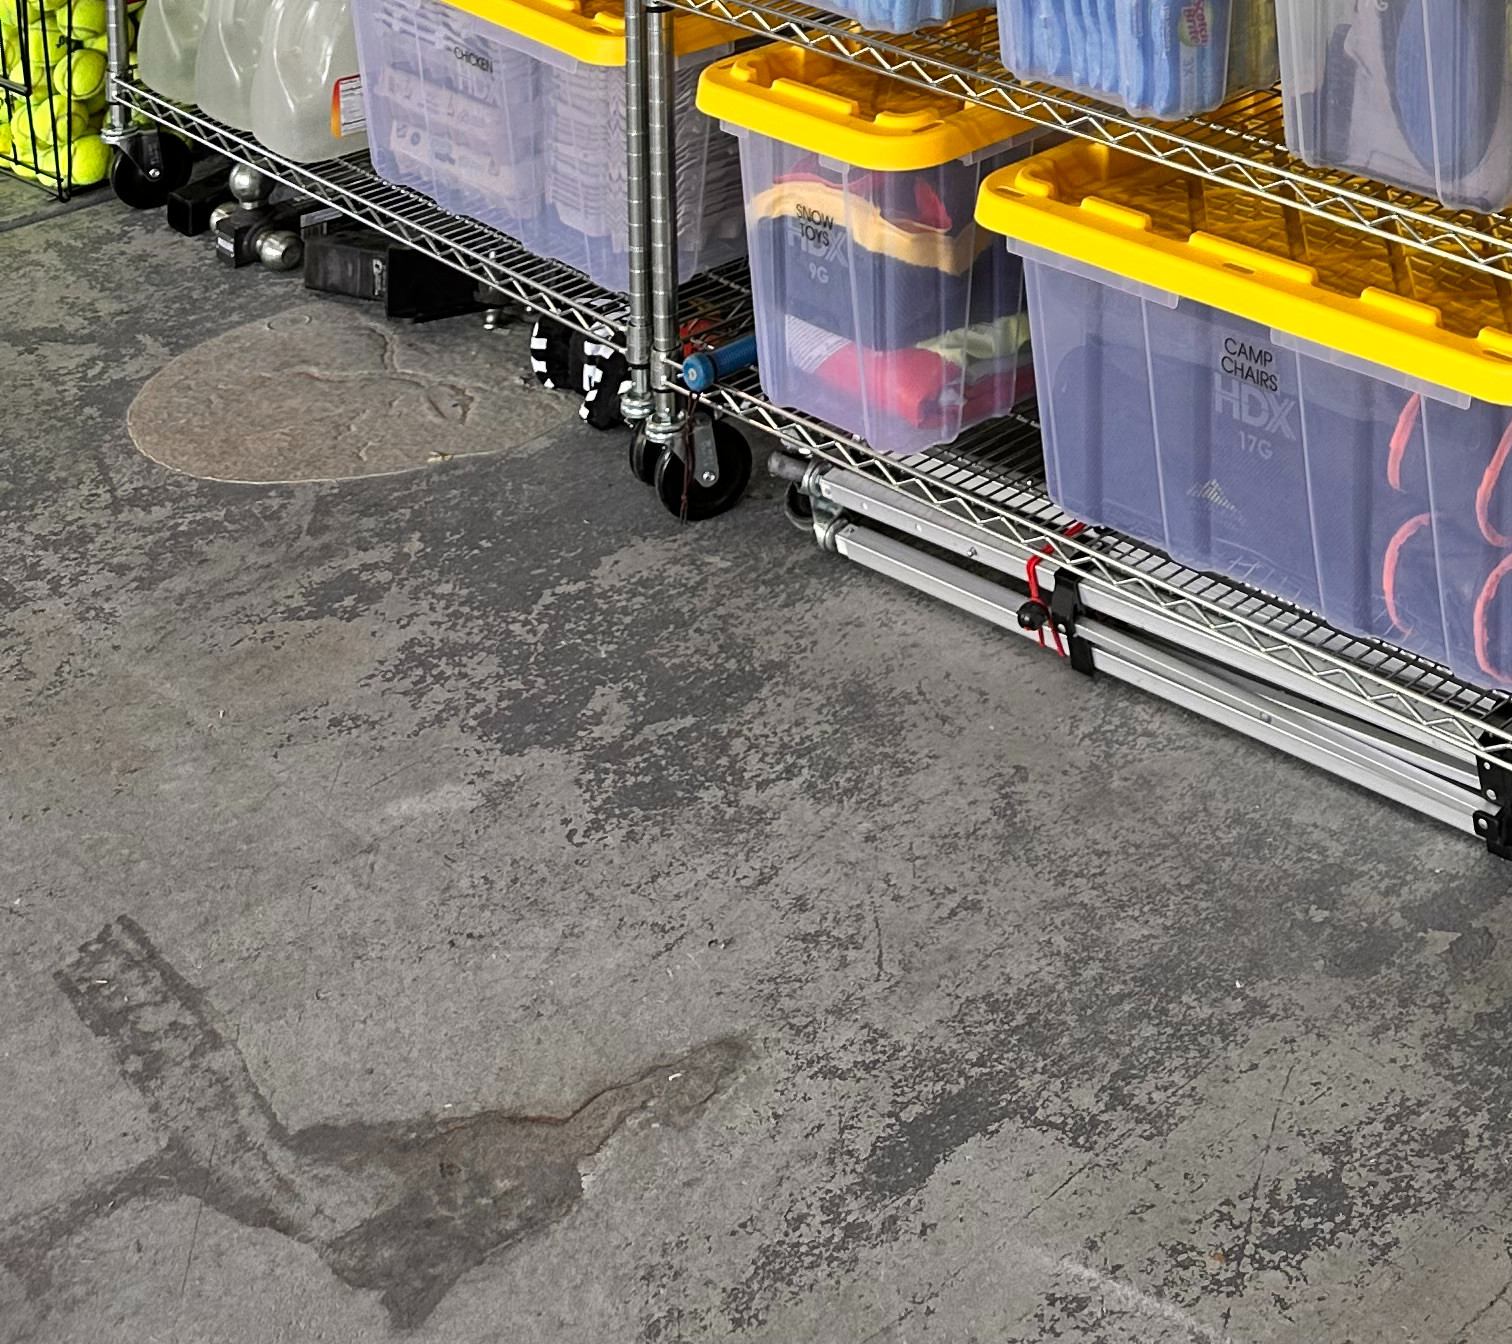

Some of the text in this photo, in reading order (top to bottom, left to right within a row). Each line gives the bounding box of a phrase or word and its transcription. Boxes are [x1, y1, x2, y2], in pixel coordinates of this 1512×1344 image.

[453, 45, 494, 74] CHICKEN
[796, 203, 835, 231] SNOW
[799, 220, 831, 248] TOYS
[809, 262, 830, 284] 9G
[1224, 336, 1274, 367] CAMP
[1220, 355, 1279, 394] CHAIRS
[1214, 373, 1296, 442] HDX
[1238, 430, 1274, 460] 17G
